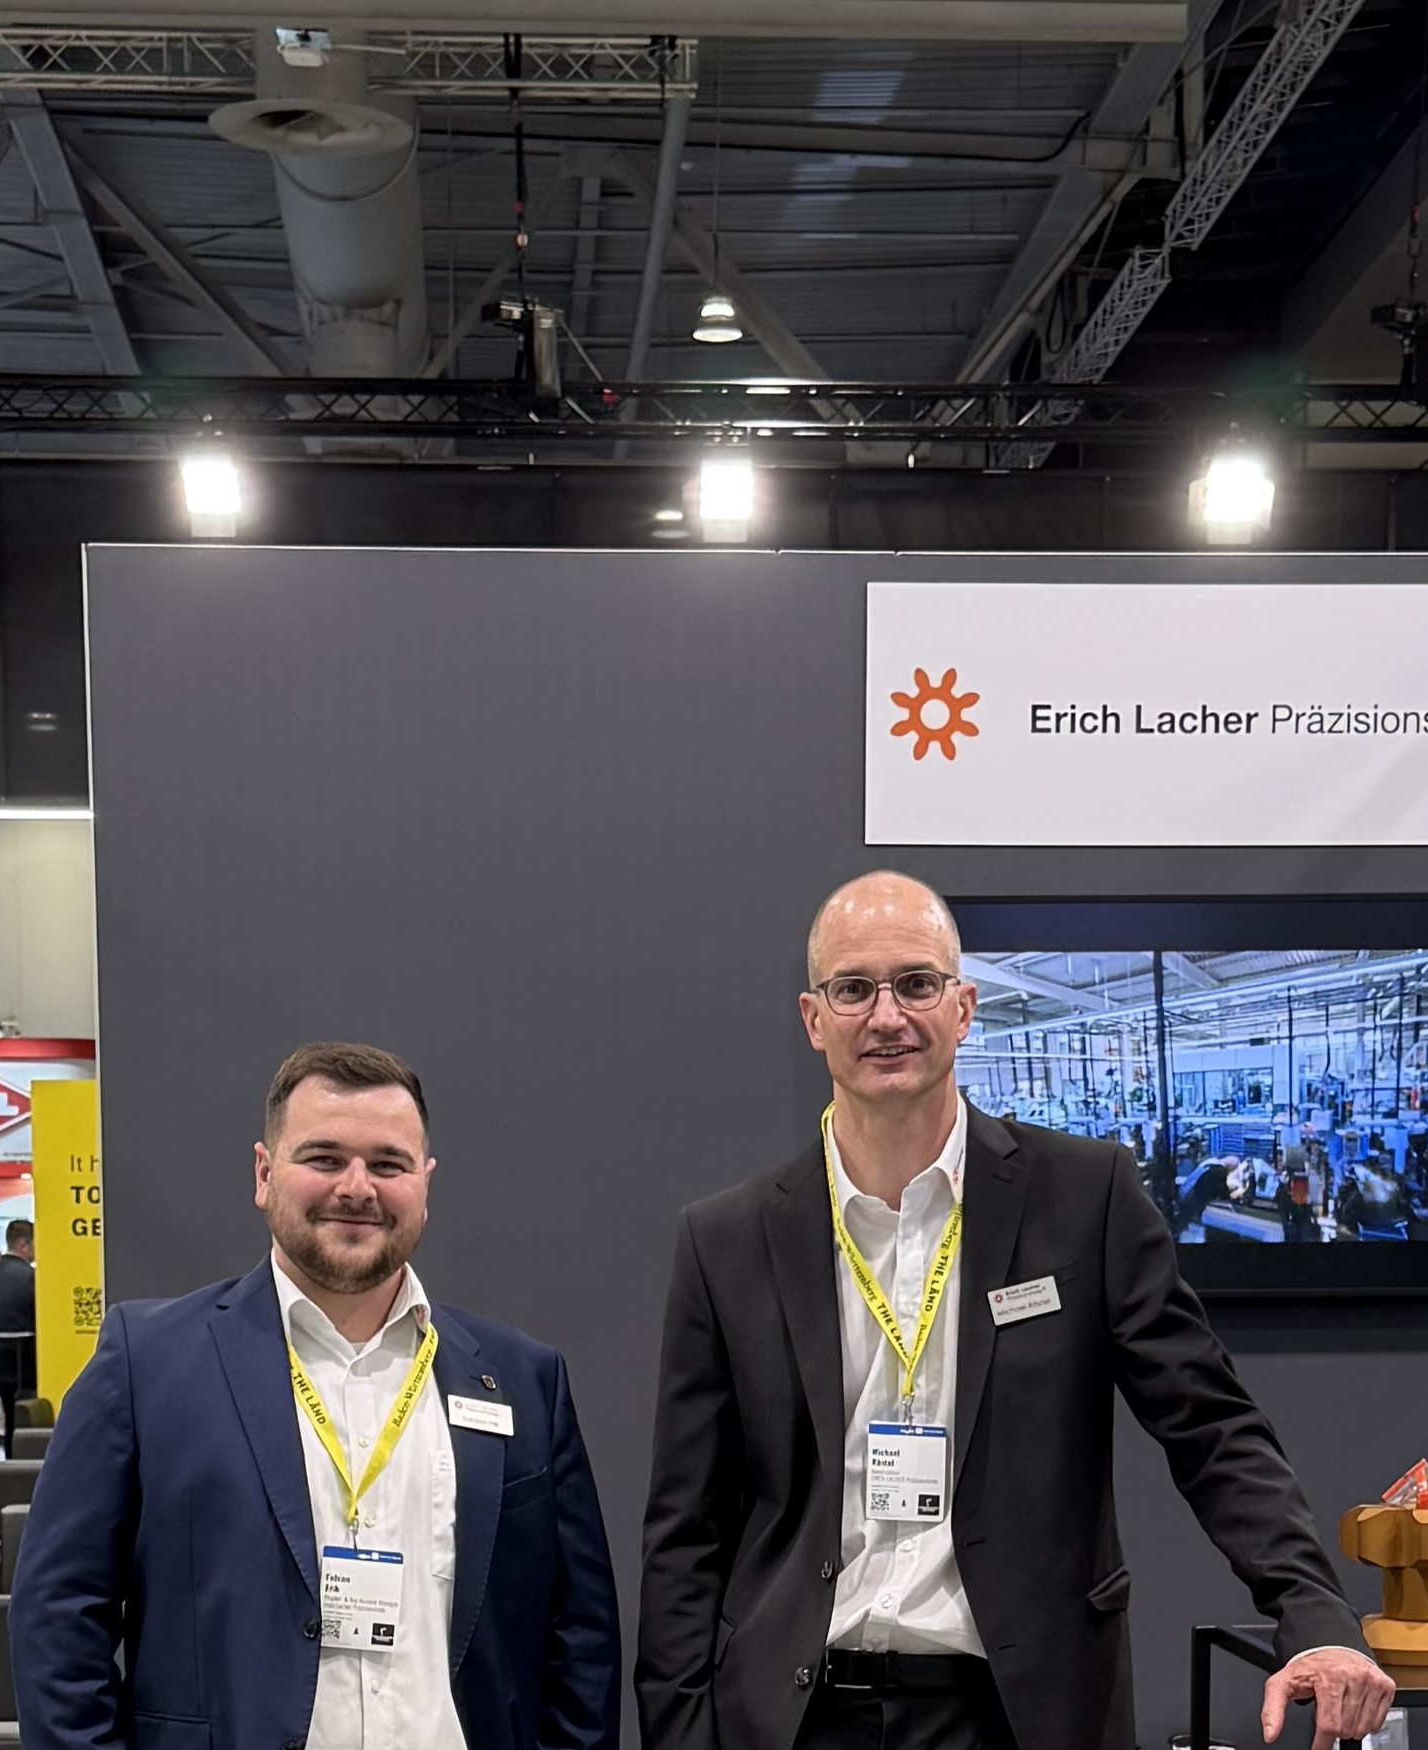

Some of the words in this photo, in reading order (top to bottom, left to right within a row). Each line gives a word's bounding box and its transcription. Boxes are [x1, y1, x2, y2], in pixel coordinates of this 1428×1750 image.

[1029, 703, 1122, 735] Erich
[1134, 703, 1259, 735] Lacher
[293, 1372, 311, 1396] THE
[305, 1394, 327, 1425] LÄND
